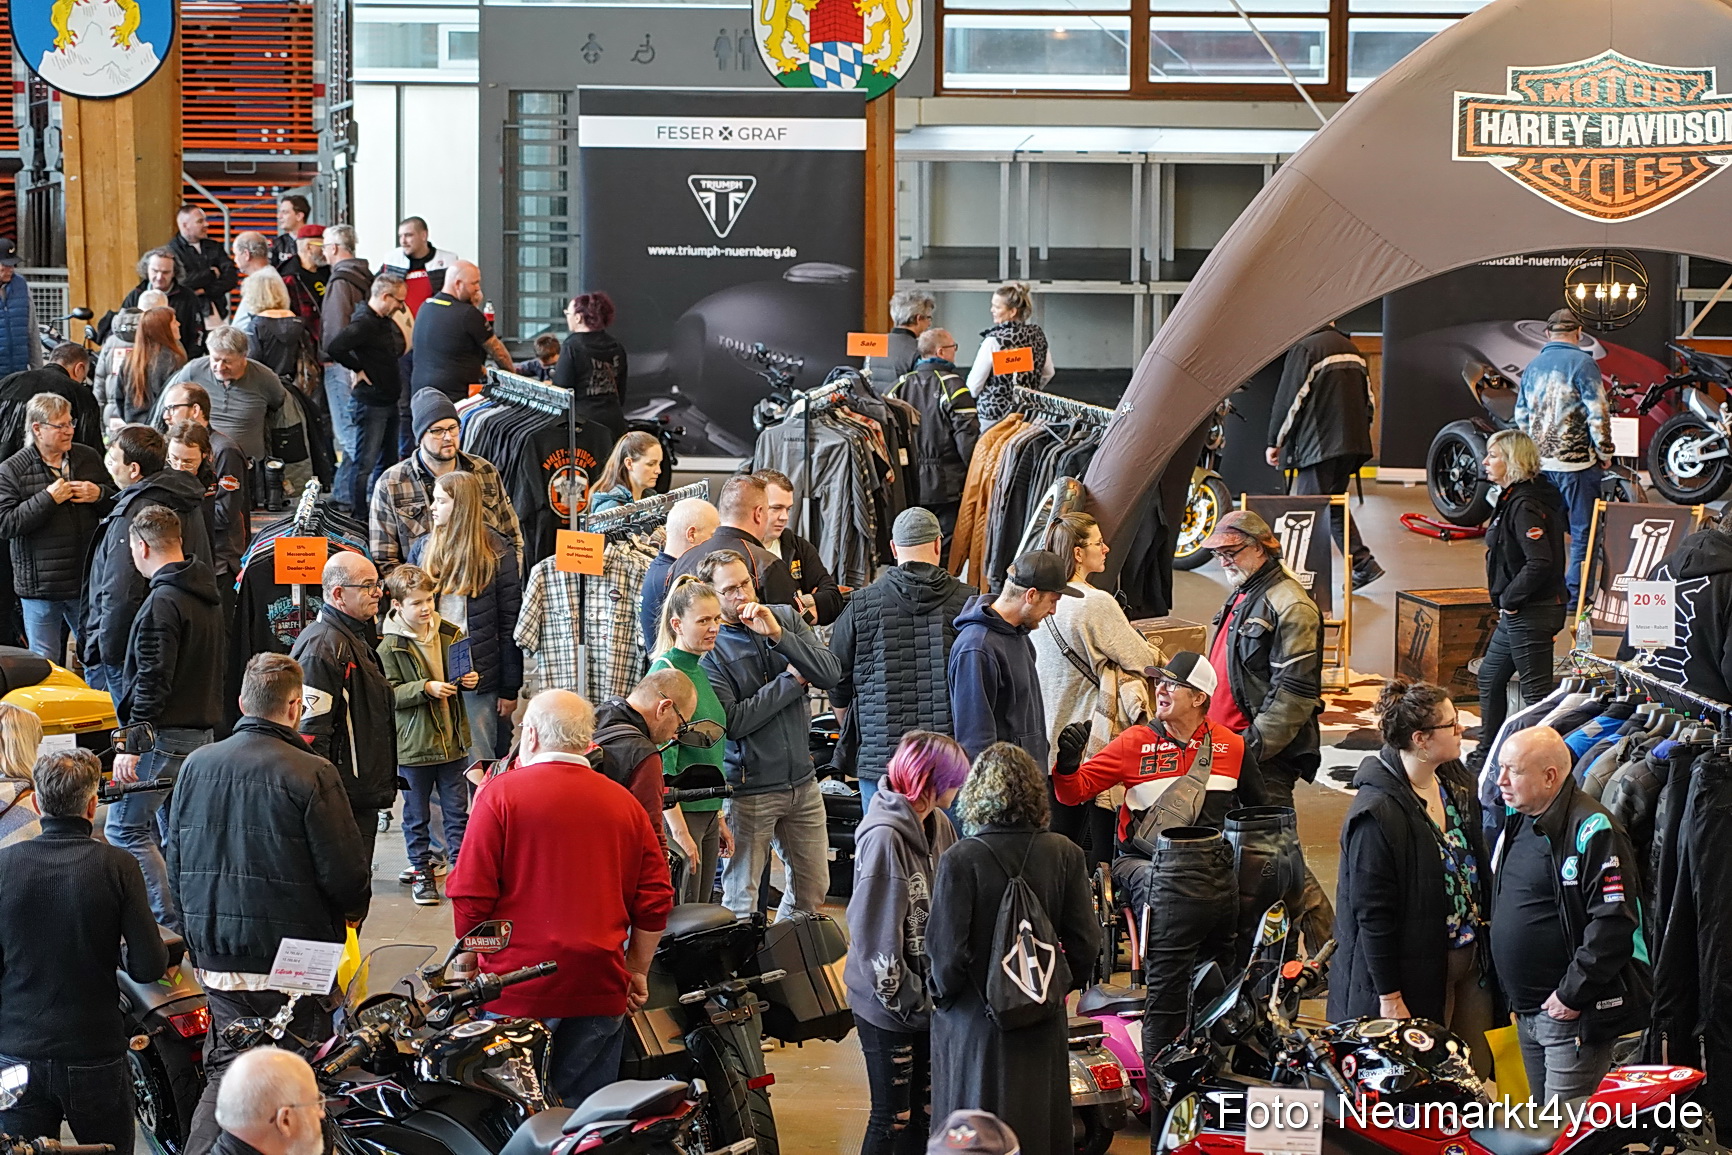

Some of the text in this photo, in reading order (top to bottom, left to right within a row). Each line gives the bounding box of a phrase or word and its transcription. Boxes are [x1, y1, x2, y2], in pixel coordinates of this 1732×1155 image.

[1543, 68, 1681, 103] MOTOR
[656, 125, 788, 141] FESER GRAF
[700, 180, 743, 190] TRIUMPH
[1542, 157, 1682, 204] CYCLES
[647, 244, 797, 260] www.triumph-nuernberg.de
[1004, 355, 1022, 364] Sale
[1633, 593, 1667, 606] 20 %
[1139, 751, 1179, 776] 63
[1358, 1065, 1405, 1079] Kawasaki
